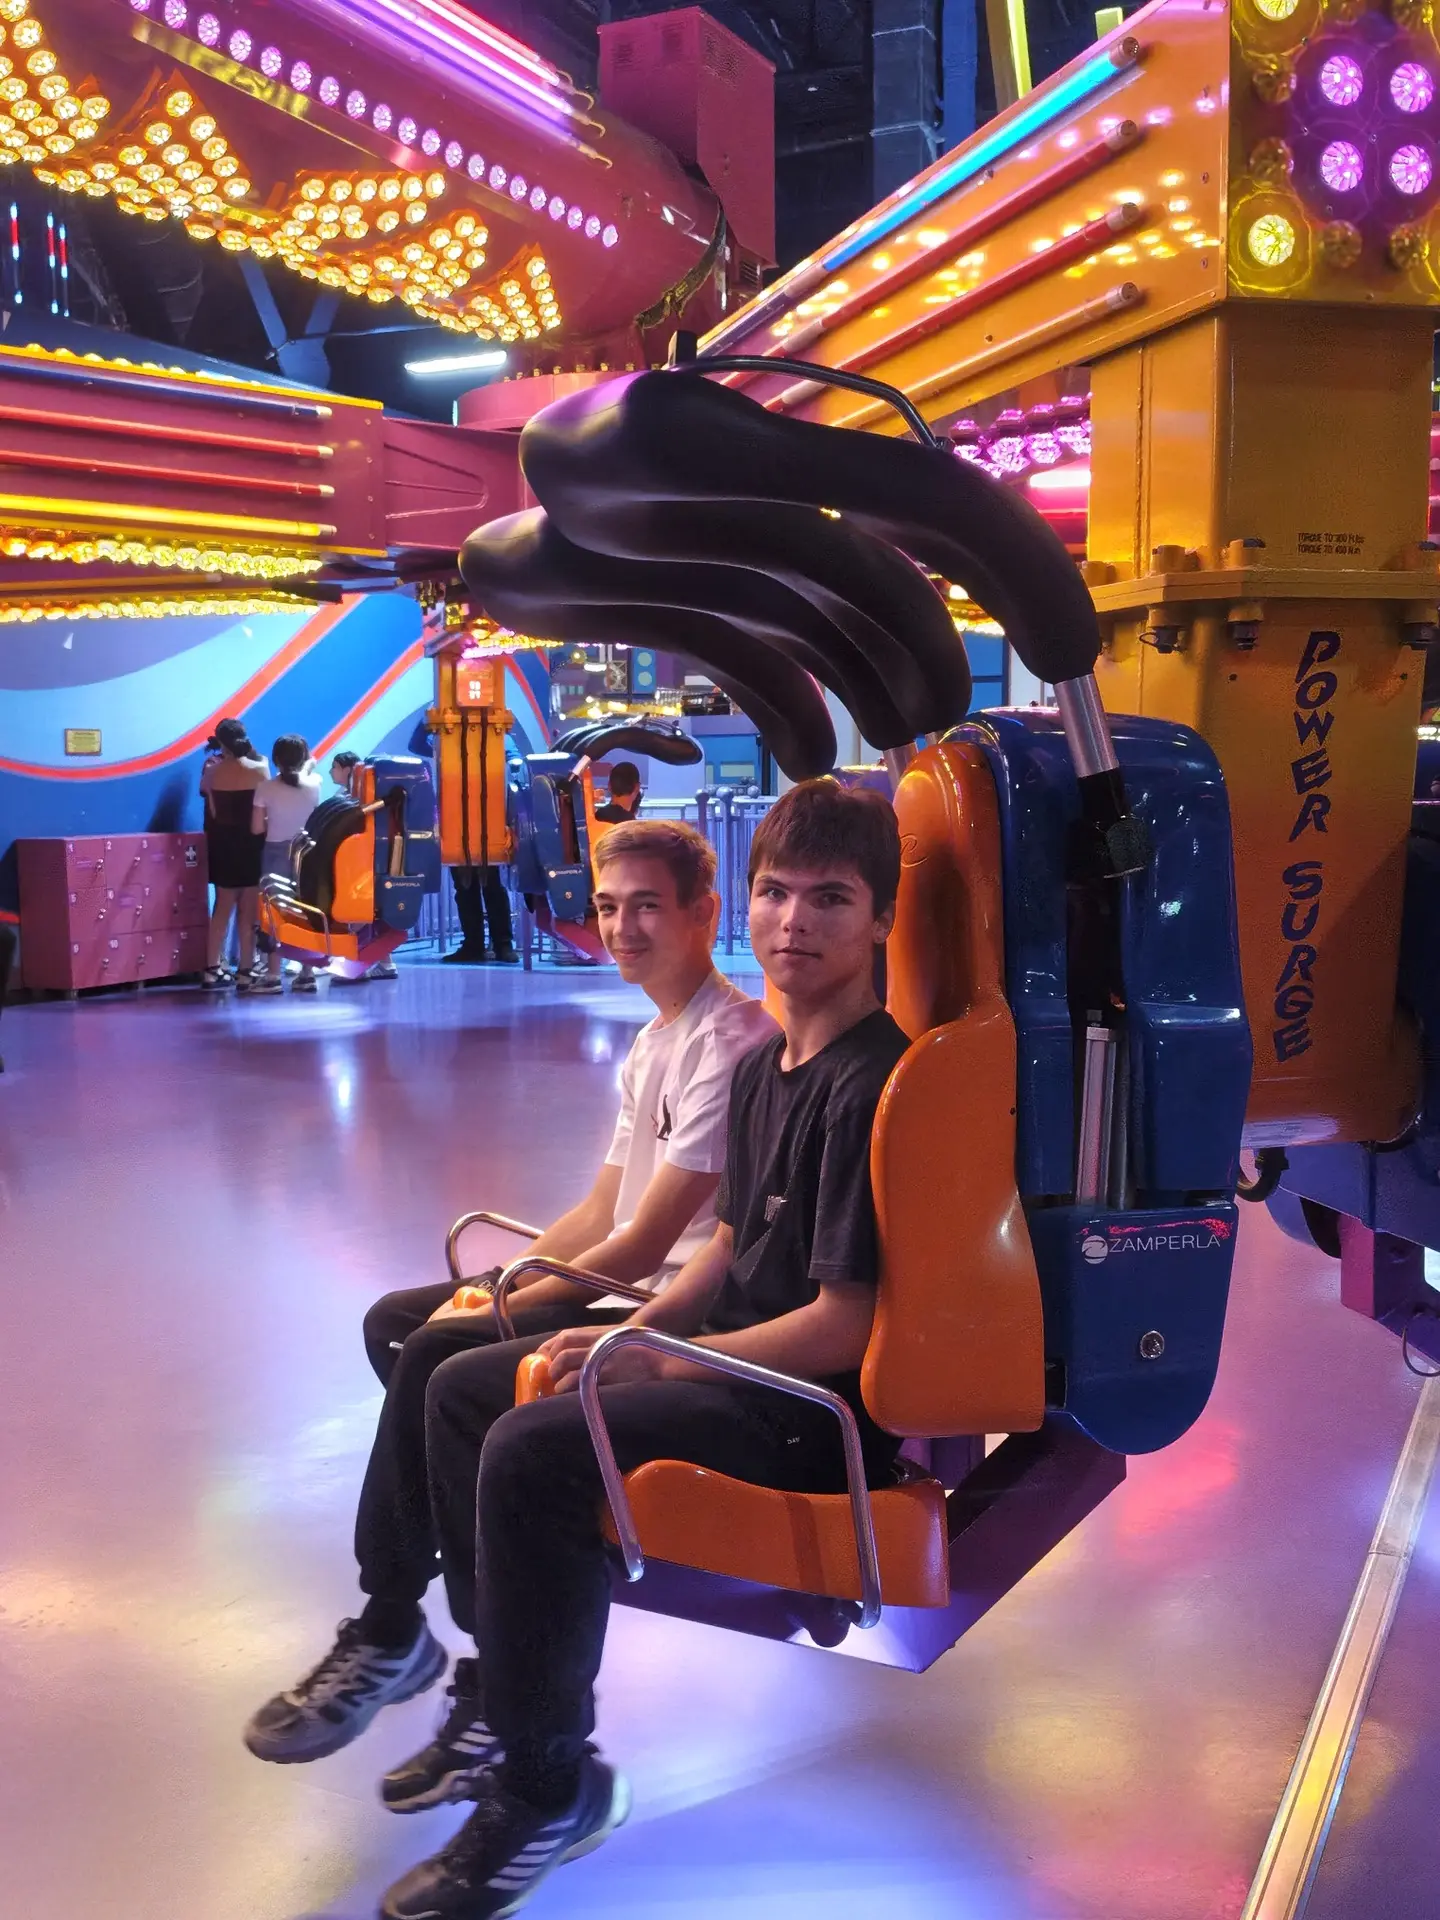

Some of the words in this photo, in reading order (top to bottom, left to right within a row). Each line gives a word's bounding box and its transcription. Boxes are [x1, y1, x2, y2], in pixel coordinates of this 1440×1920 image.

[1324, 533, 1334, 543] TO
[1323, 544, 1334, 554] TO
[1288, 631, 1342, 843] POWER
[1273, 861, 1323, 1063] SURGE
[1109, 1234, 1221, 1253] ZAMPERLA
